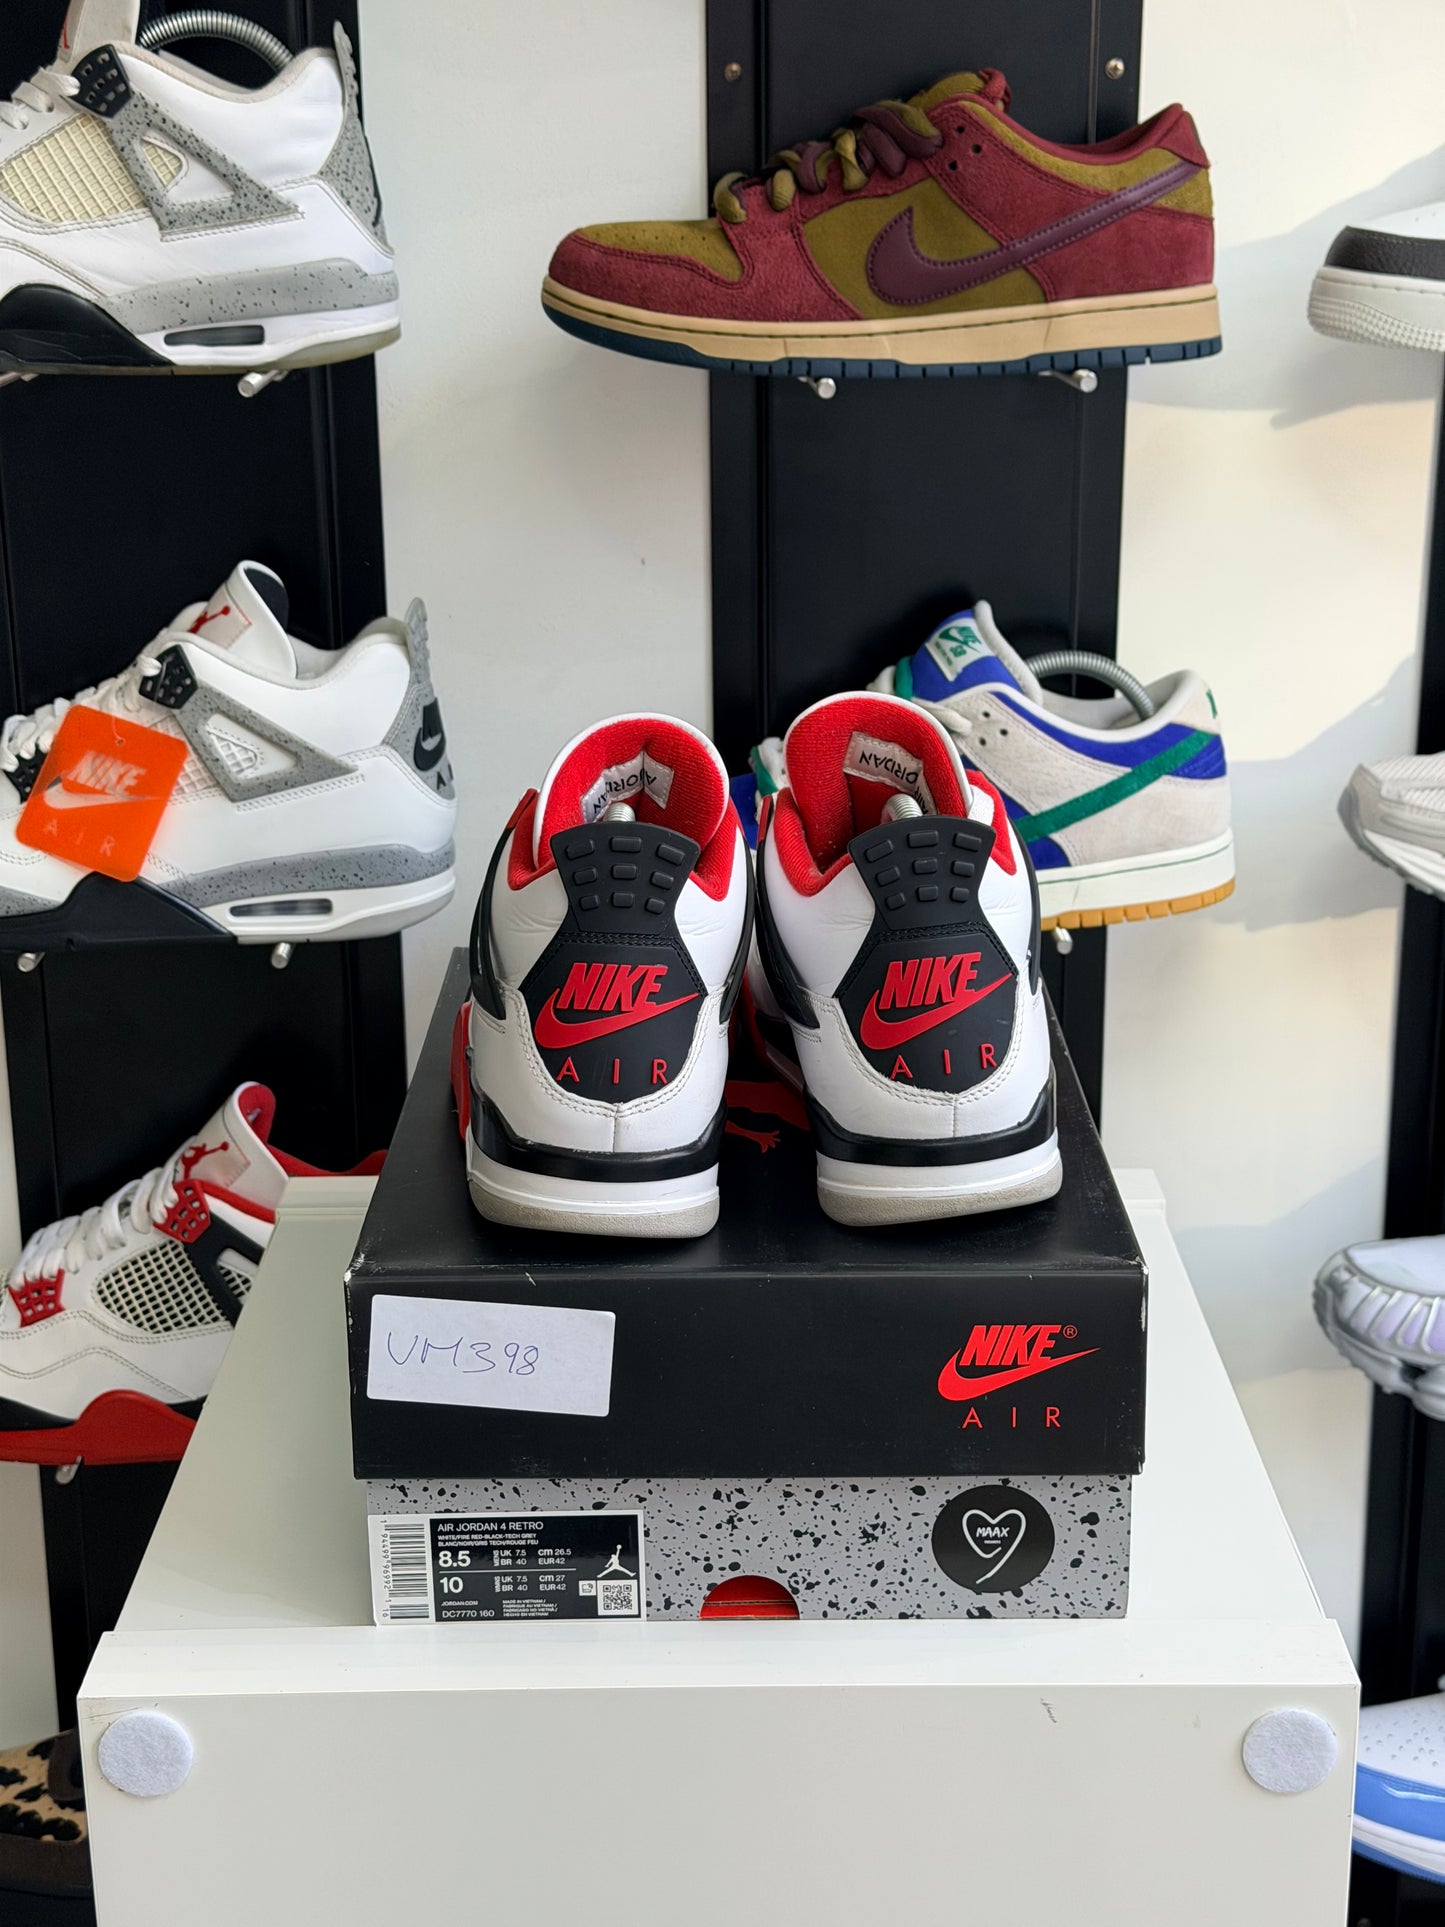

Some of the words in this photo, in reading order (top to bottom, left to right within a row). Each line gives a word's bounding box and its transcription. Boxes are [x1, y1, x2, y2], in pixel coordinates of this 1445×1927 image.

[67, 750, 147, 796] NIKE
[859, 750, 919, 784] ORDAN
[44, 819, 115, 857] AIR
[556, 962, 668, 1012] NIKE
[878, 952, 982, 1010] NIKE
[556, 1056, 668, 1085] AIR
[890, 1043, 997, 1080] AIR
[962, 1406, 1061, 1429] AIR
[437, 1523, 454, 1532] AIR
[456, 1523, 498, 1532] JORDAN
[500, 1522, 507, 1530] 4
[509, 1521, 544, 1530] RETRO
[976, 1526, 1010, 1538] MAAX
[438, 1550, 471, 1567] 8.5
[554, 1548, 572, 1556] 26.5
[440, 1576, 463, 1594] 10
[442, 1610, 477, 1618] DC7770
